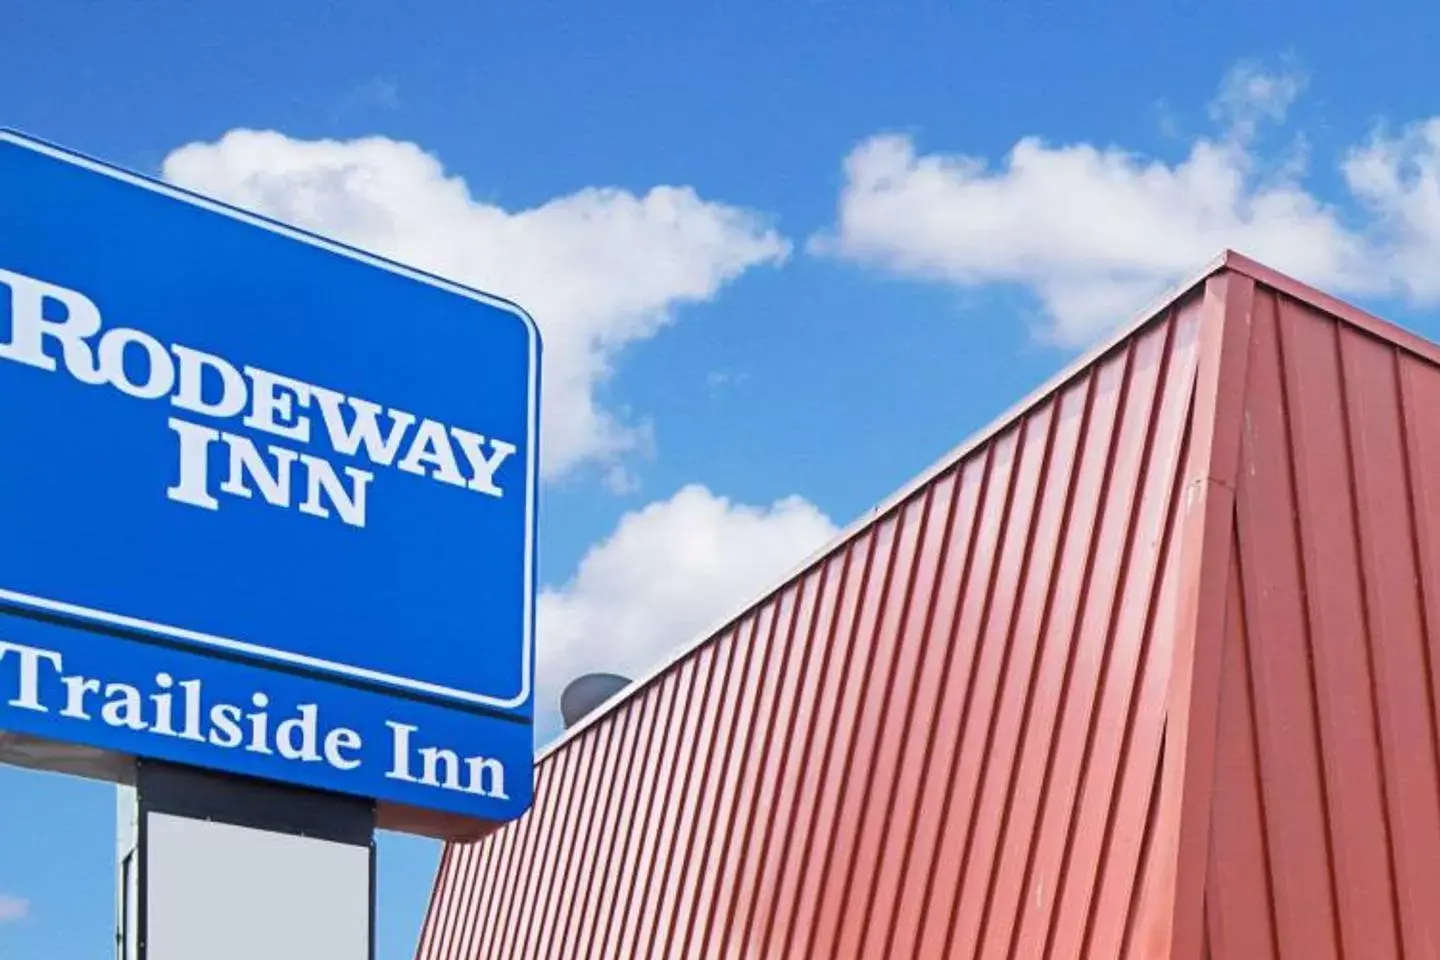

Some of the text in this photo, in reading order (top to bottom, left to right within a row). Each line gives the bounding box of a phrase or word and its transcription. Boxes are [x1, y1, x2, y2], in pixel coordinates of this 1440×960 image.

[0, 268, 516, 498] RODEWAY
[167, 417, 374, 528] INN
[0, 641, 511, 801] Trailside Inn
